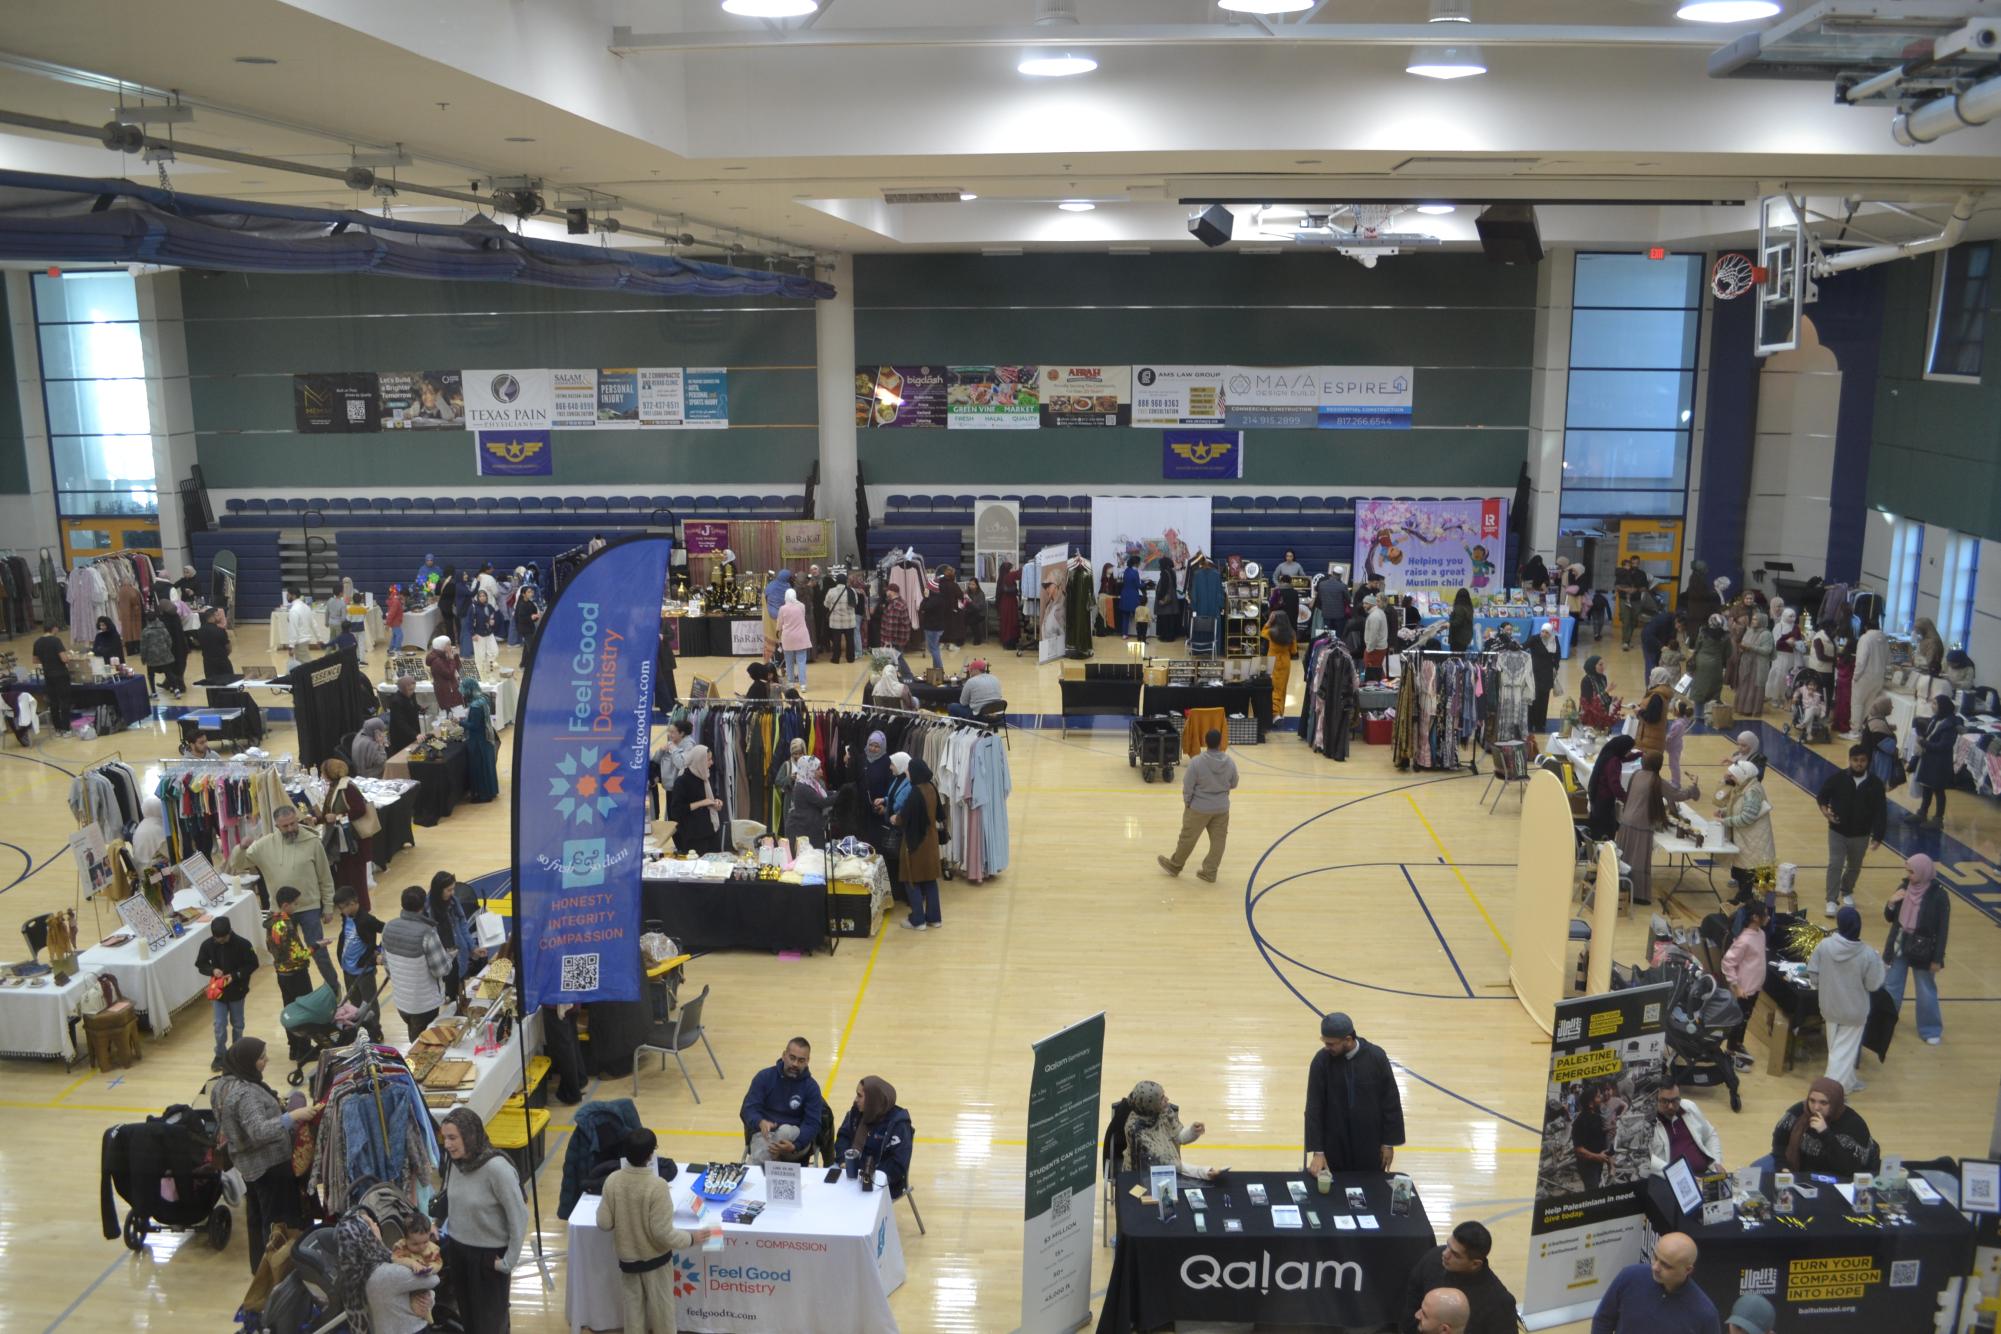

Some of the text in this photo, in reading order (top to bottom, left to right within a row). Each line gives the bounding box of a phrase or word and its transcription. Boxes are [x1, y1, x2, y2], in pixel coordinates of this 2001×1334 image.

[601, 384, 634, 394] PERSONAL
[1324, 382, 1388, 394] ESPIRE
[601, 394, 624, 403] INJURY
[468, 408, 546, 420] TEXAS PAIN
[1408, 556, 1464, 566] Helping you
[1405, 568, 1427, 576] raise
[1440, 568, 1465, 578] great
[1406, 578, 1464, 587] Muslim child
[569, 602, 600, 732] Feel Good
[593, 628, 624, 732] Dentistry
[630, 660, 650, 770] feelgoodtx.com
[537, 853, 548, 865] so
[546, 857, 576, 874] fresh
[601, 848, 630, 869] clean
[552, 893, 614, 912] HONESTY
[548, 912, 616, 930] INTEGRITY
[539, 928, 624, 950] COMPASSION
[1044, 1056, 1068, 1072] Qalam
[1556, 1050, 1612, 1068] PALESTINE
[1556, 1062, 1618, 1081] EMERGENCY
[1028, 1138, 1096, 1178] STUDENTS CAN ENROLL
[1545, 1206, 1562, 1216] Help
[1562, 1198, 1606, 1212] Palestinians
[1616, 1192, 1636, 1201] need.
[1544, 1210, 1584, 1224] Give today.
[1051, 1222, 1078, 1241] MILLION
[756, 1238, 827, 1252] COMPASSION
[709, 1264, 792, 1282] Feel Good
[1180, 1250, 1363, 1296] Qalam
[1791, 1258, 1870, 1272] TURN YOUR
[1790, 1272, 1880, 1286] COMPASSION
[710, 1279, 776, 1296] Dentistry
[1788, 1286, 1862, 1300] INTO HOPE
[686, 1308, 757, 1321] feelgoodtx.com
[1798, 1305, 1856, 1314] baitulmaal.org
